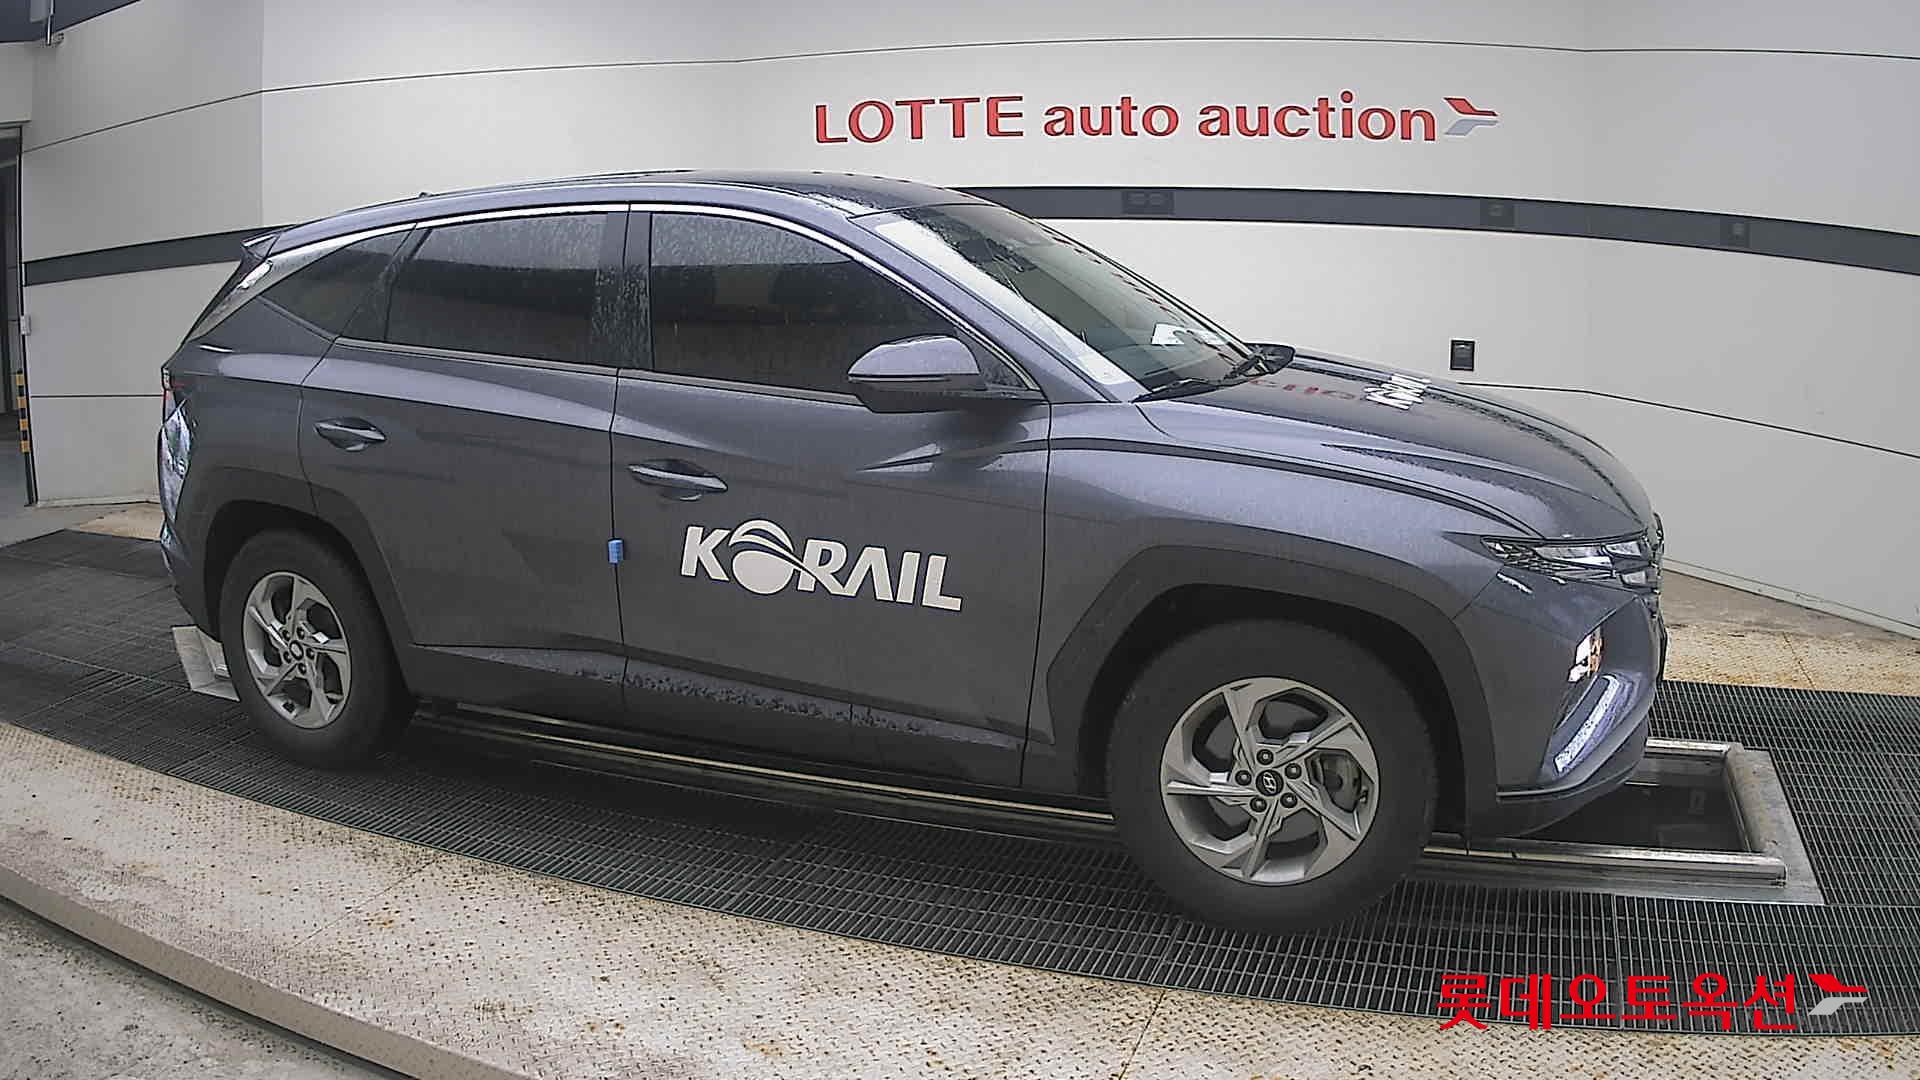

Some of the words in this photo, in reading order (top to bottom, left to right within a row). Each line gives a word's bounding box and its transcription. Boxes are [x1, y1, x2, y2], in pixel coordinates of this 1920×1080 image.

[815, 95, 1024, 143] LOTTE
[1042, 96, 1180, 138] auto
[1198, 91, 1437, 142] auction
[680, 518, 963, 611] KORAIL
